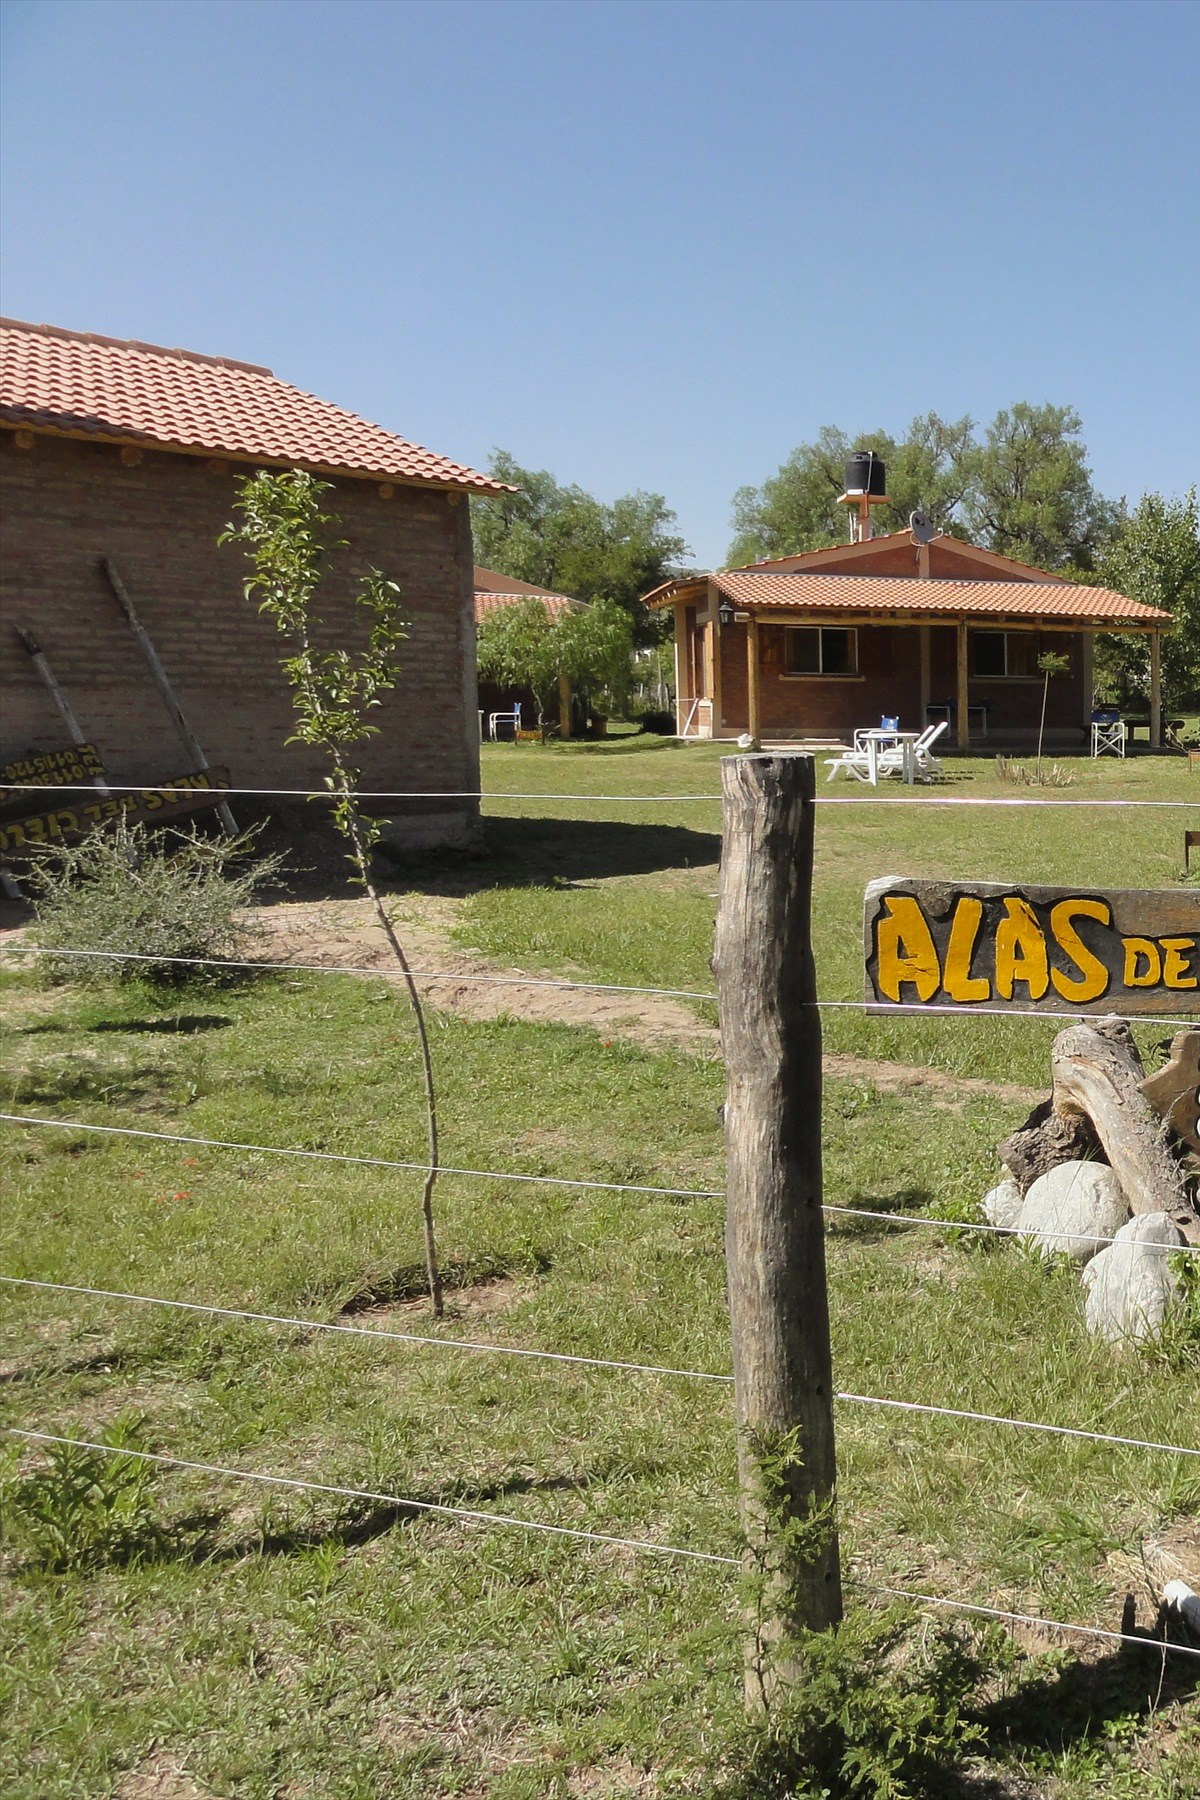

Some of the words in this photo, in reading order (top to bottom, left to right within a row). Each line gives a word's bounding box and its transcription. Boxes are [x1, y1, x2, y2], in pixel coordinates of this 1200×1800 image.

[84, 795, 138, 820] DEL
[140, 773, 210, 810] ALAS
[877, 897, 1110, 1002] ALAS
